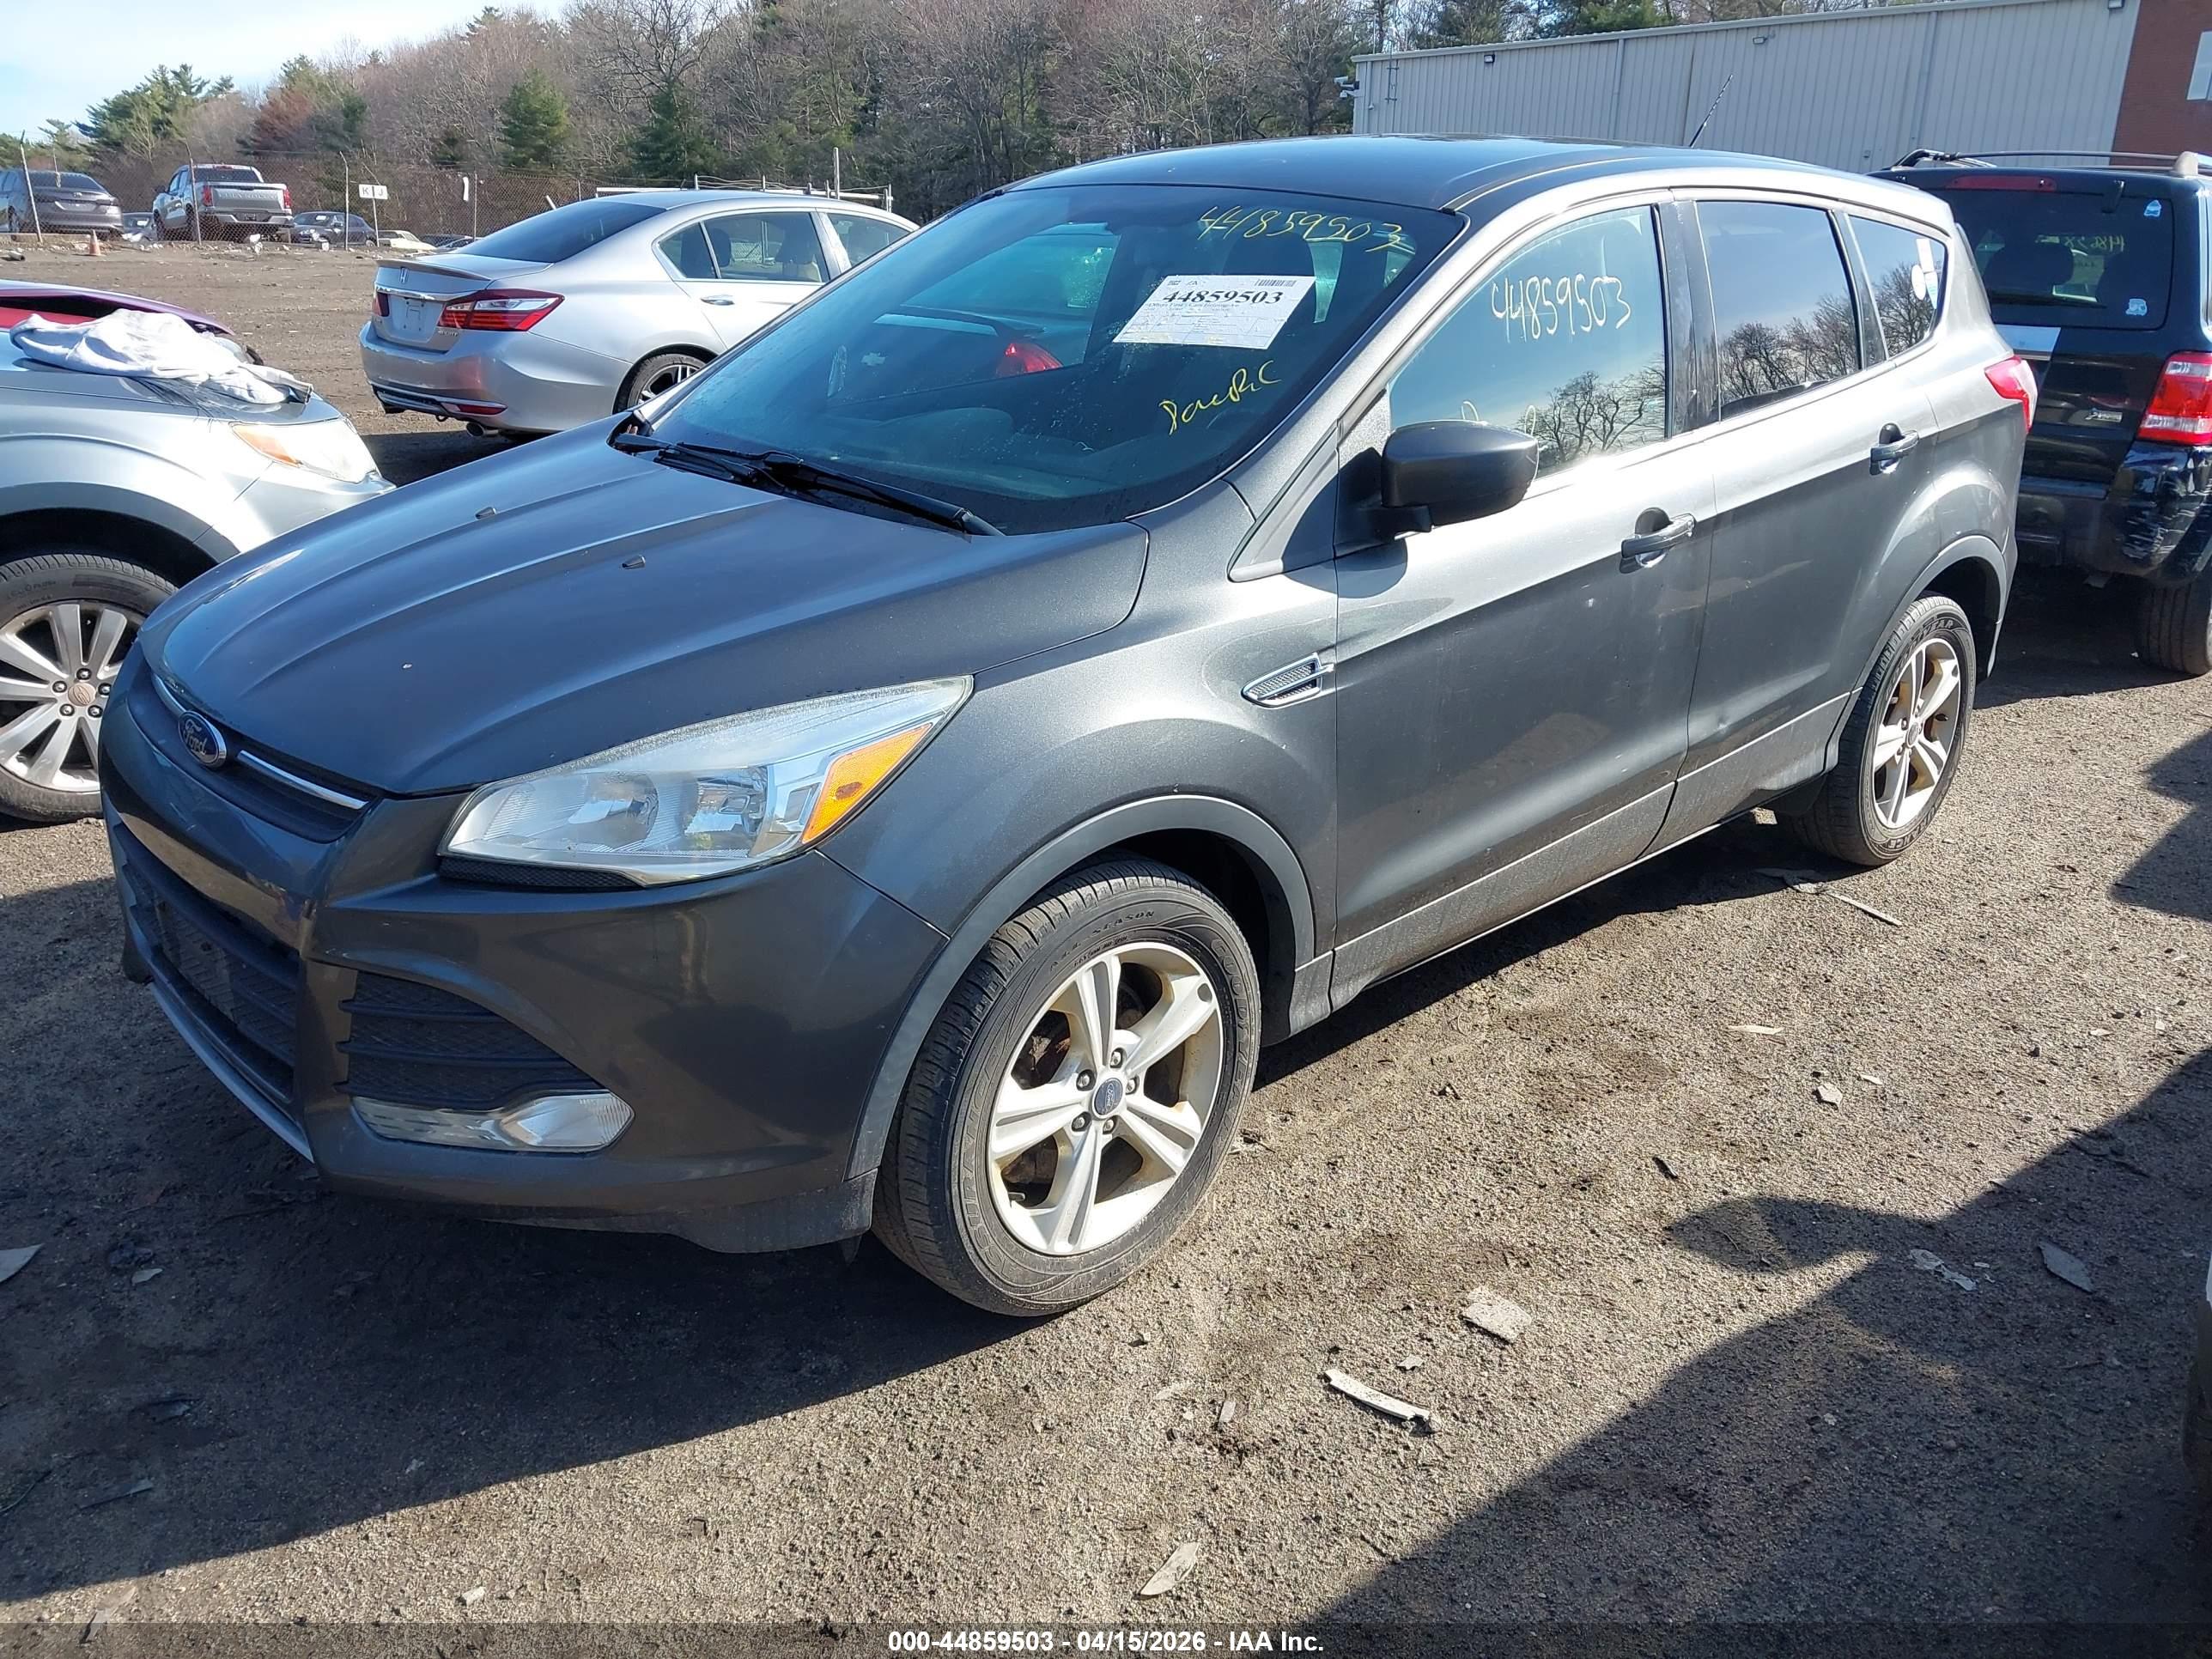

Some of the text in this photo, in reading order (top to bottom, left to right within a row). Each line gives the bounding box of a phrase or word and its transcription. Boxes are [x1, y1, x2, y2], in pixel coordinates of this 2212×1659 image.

[362, 186, 369, 196] K
[1198, 206, 1402, 252] 44859503
[1163, 290, 1284, 303] 44859503
[1492, 274, 1631, 343] 44859503
[183, 719, 208, 756] Ford
[1092, 910, 1155, 936] SEASON
[1210, 938, 1249, 1142] GOODYEAR
